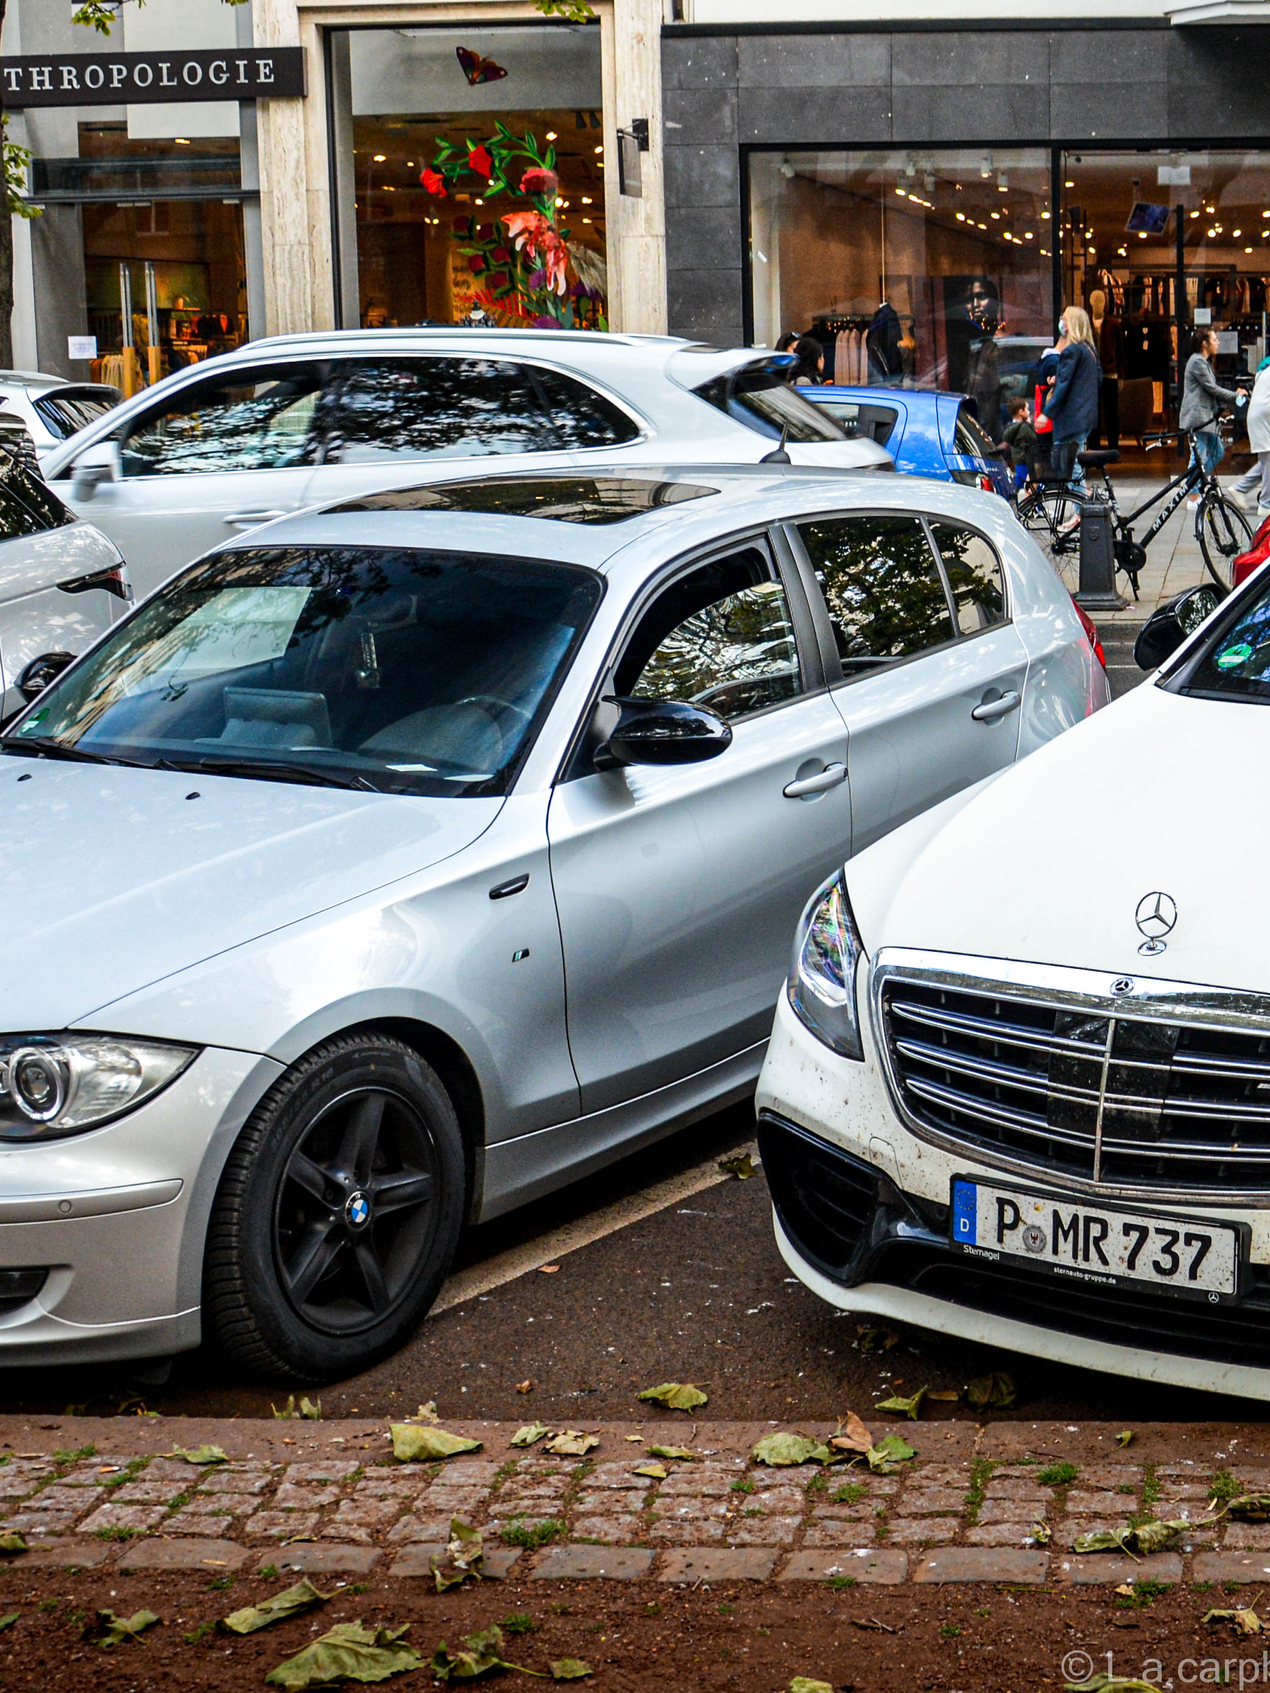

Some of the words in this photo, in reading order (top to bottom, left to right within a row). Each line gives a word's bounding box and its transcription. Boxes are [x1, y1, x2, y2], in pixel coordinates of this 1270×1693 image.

[4, 60, 275, 91] THROPOLOGIE
[1152, 484, 1188, 531] MAXIM
[960, 1217, 970, 1233] D
[996, 1196, 1020, 1244] P
[1052, 1208, 1110, 1266] MR
[1122, 1222, 1213, 1281] 737
[963, 1244, 1001, 1261] Sternagel
[1053, 1266, 1117, 1285] sternauto-gruppe.de
